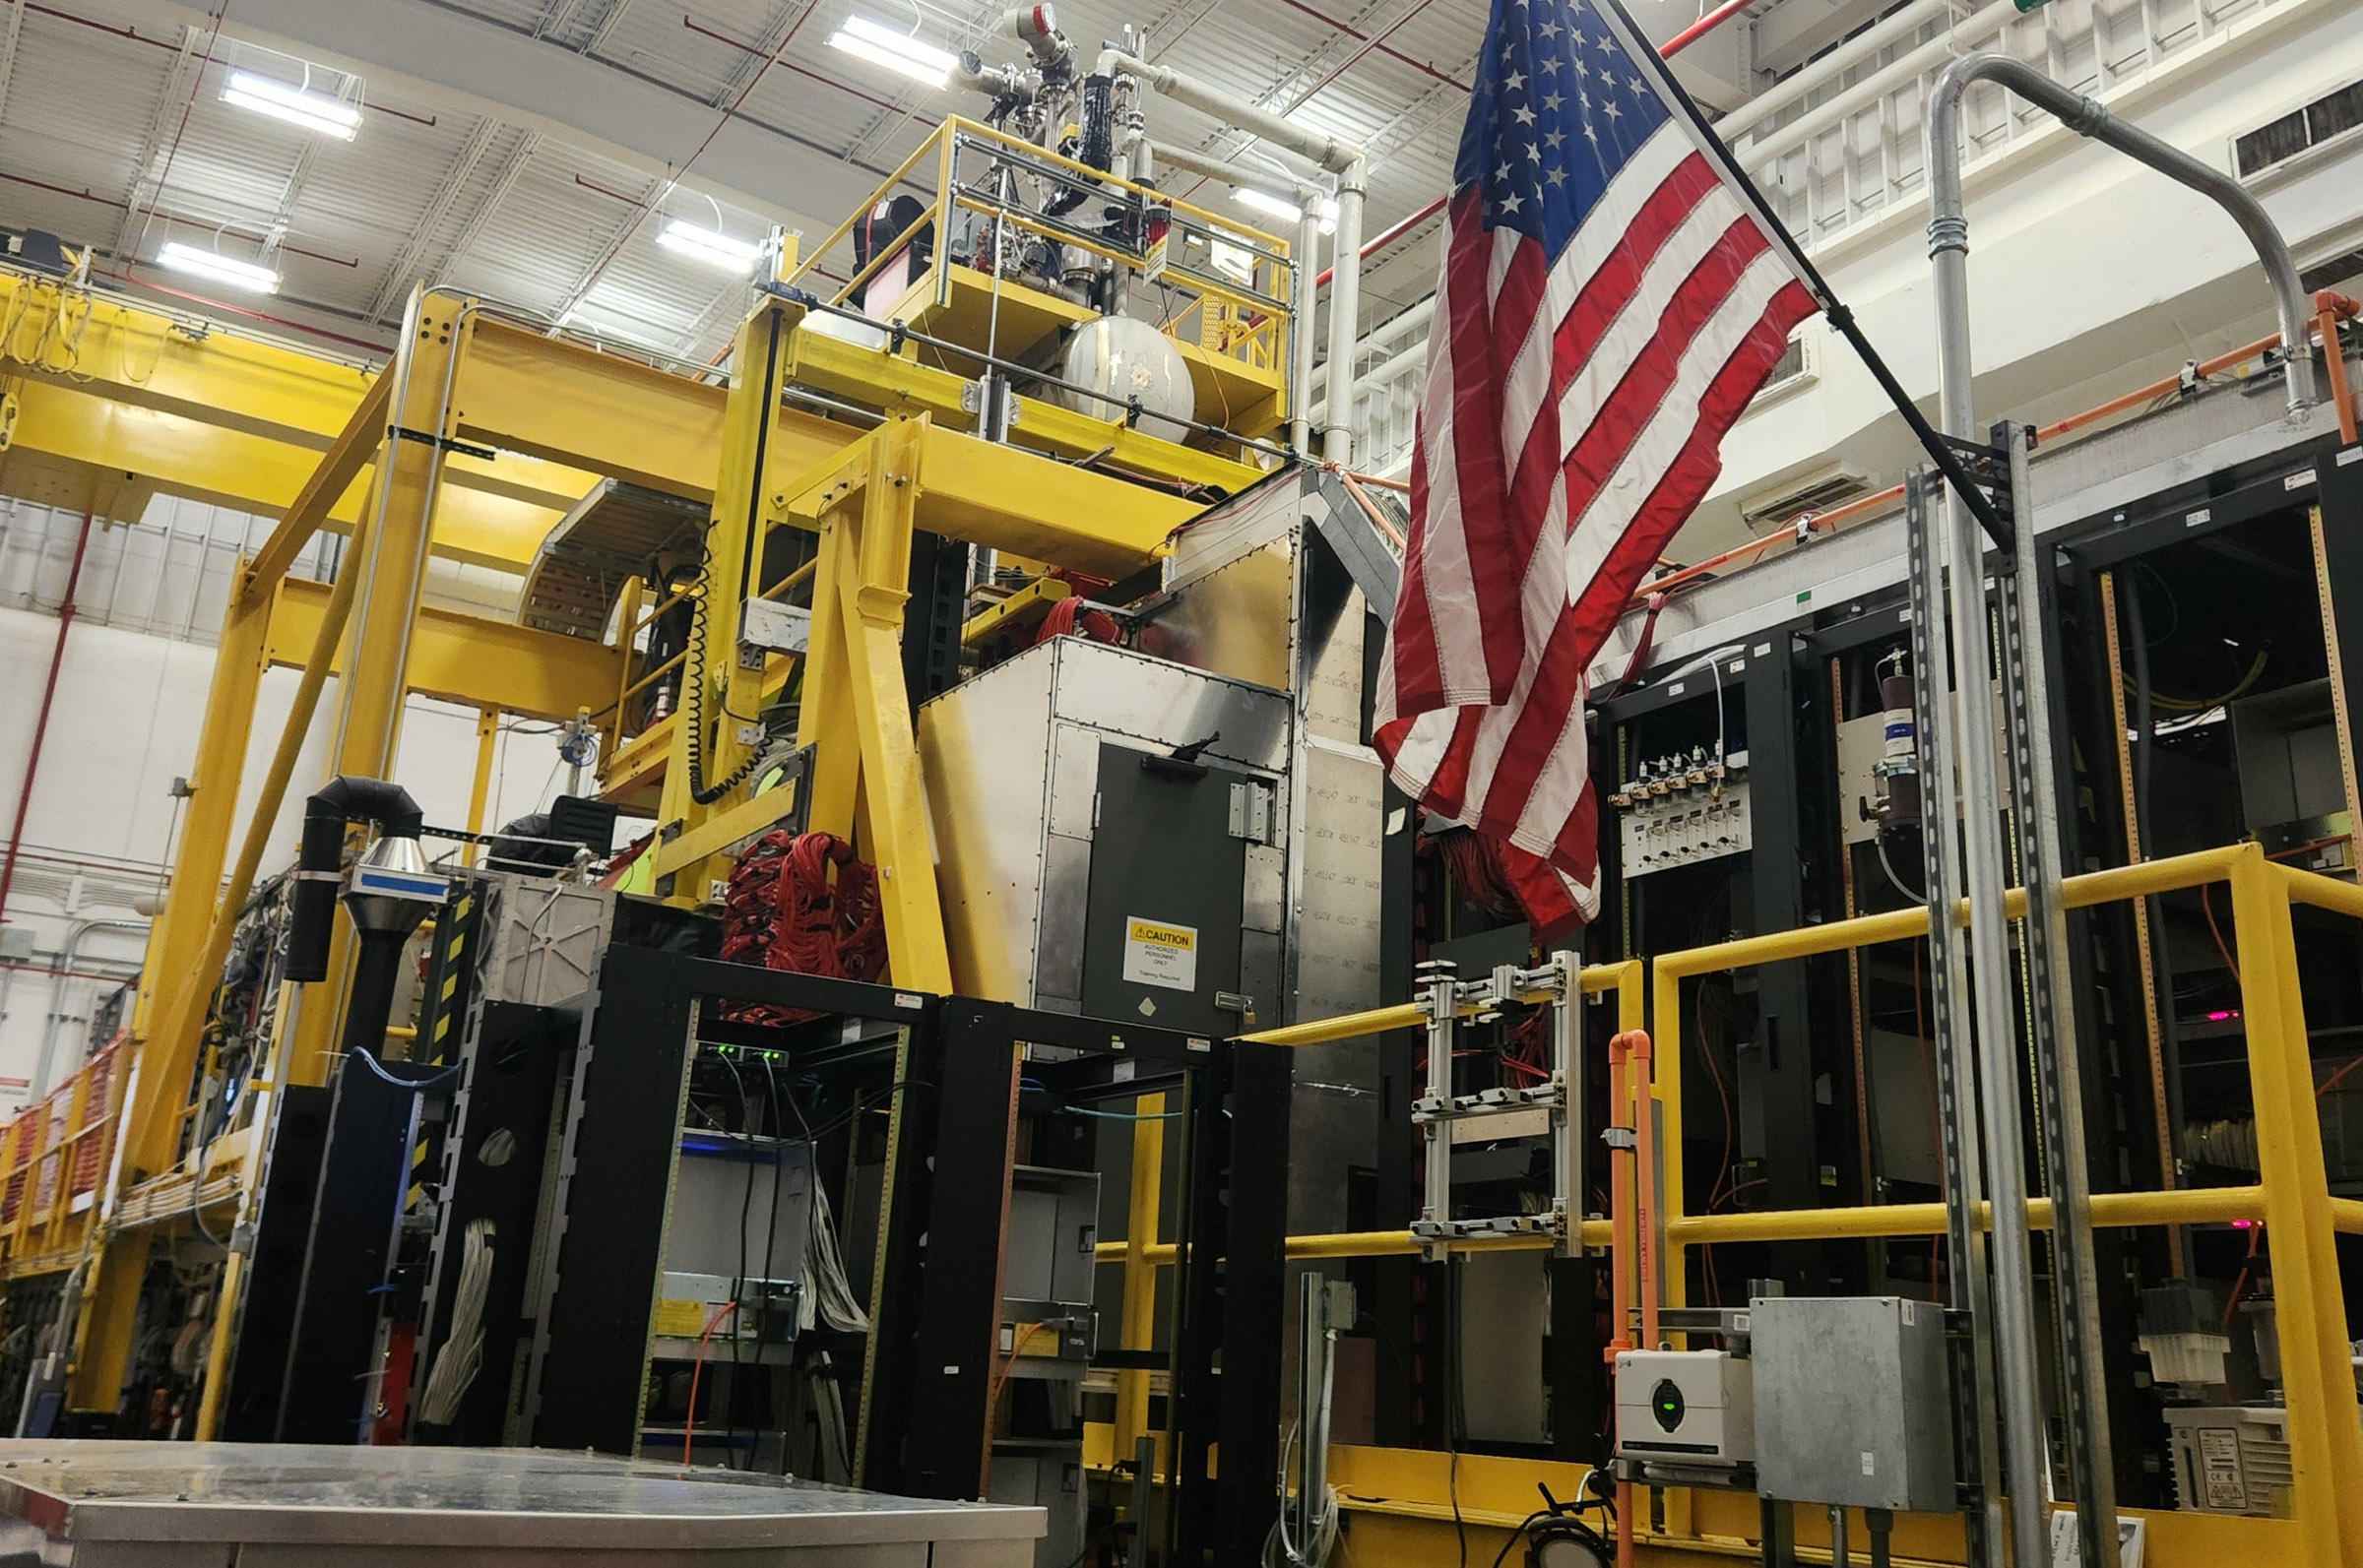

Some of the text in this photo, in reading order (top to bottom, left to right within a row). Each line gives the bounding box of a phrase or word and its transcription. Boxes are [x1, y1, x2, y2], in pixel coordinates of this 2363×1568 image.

[1146, 930, 1188, 945] CAUTION
[1144, 944, 1179, 954] AUTHORIZED
[1145, 951, 1177, 961] PERSONNEL
